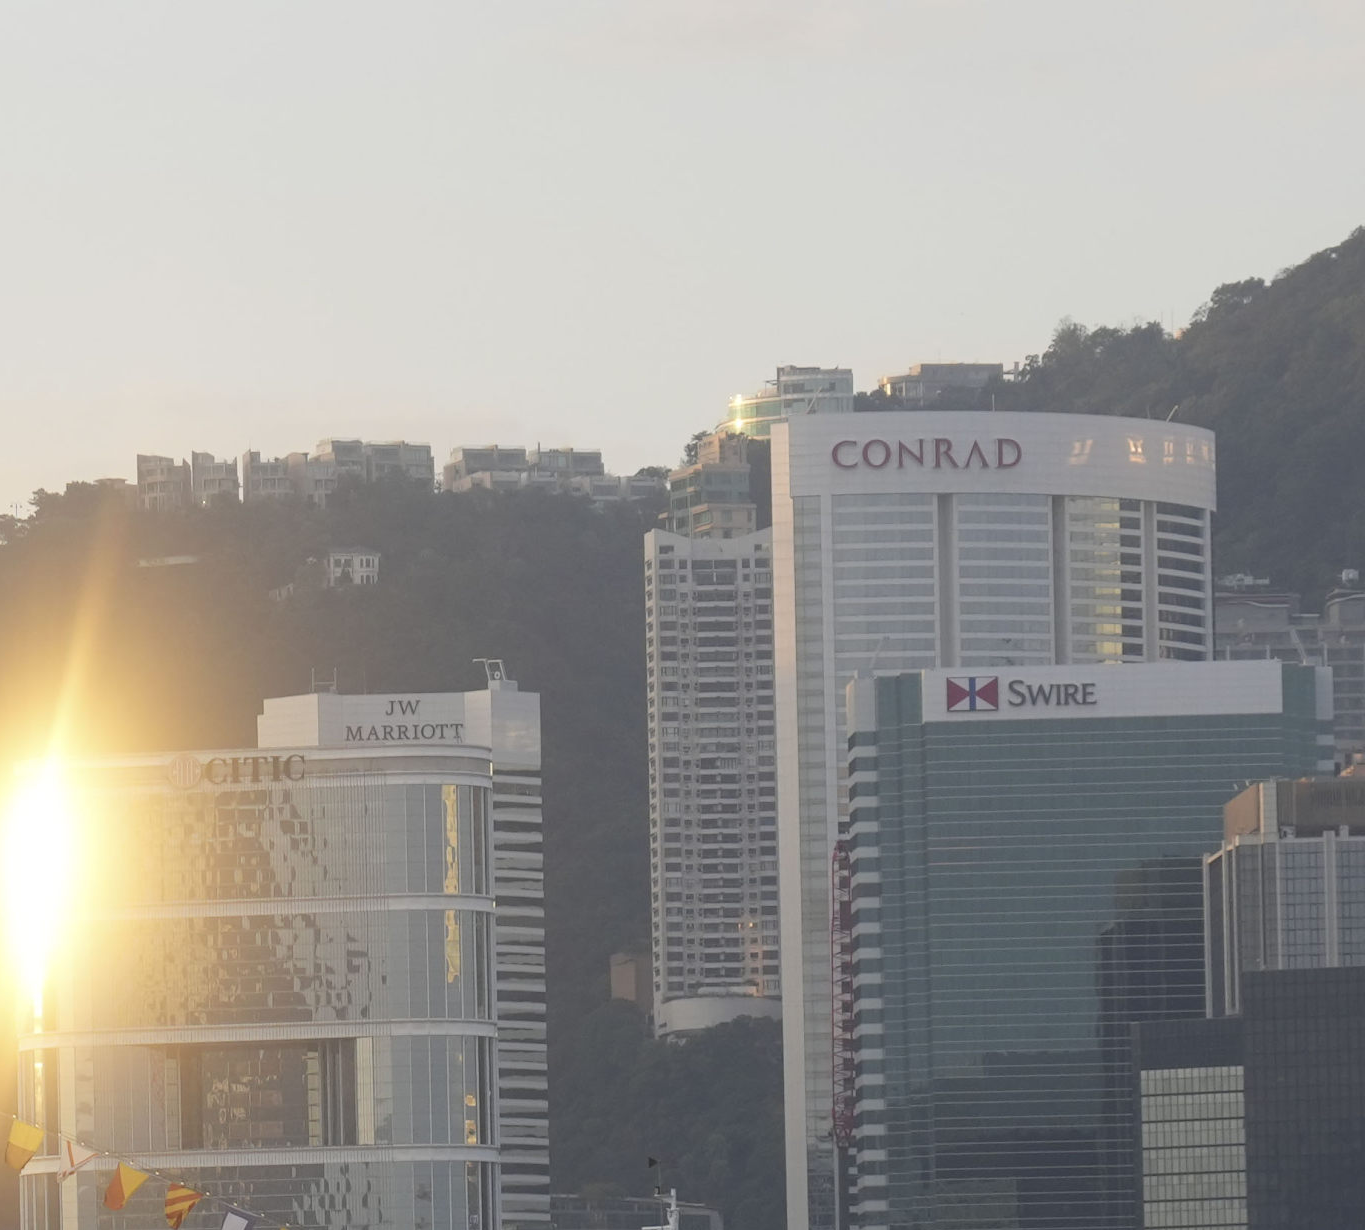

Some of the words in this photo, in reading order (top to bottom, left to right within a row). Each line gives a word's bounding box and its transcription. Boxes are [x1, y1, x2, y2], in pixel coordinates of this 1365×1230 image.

[831, 437, 1023, 471] CONRAD
[385, 699, 421, 717] JW
[345, 723, 464, 742] MARRIOTT
[204, 754, 305, 785] CITIC
